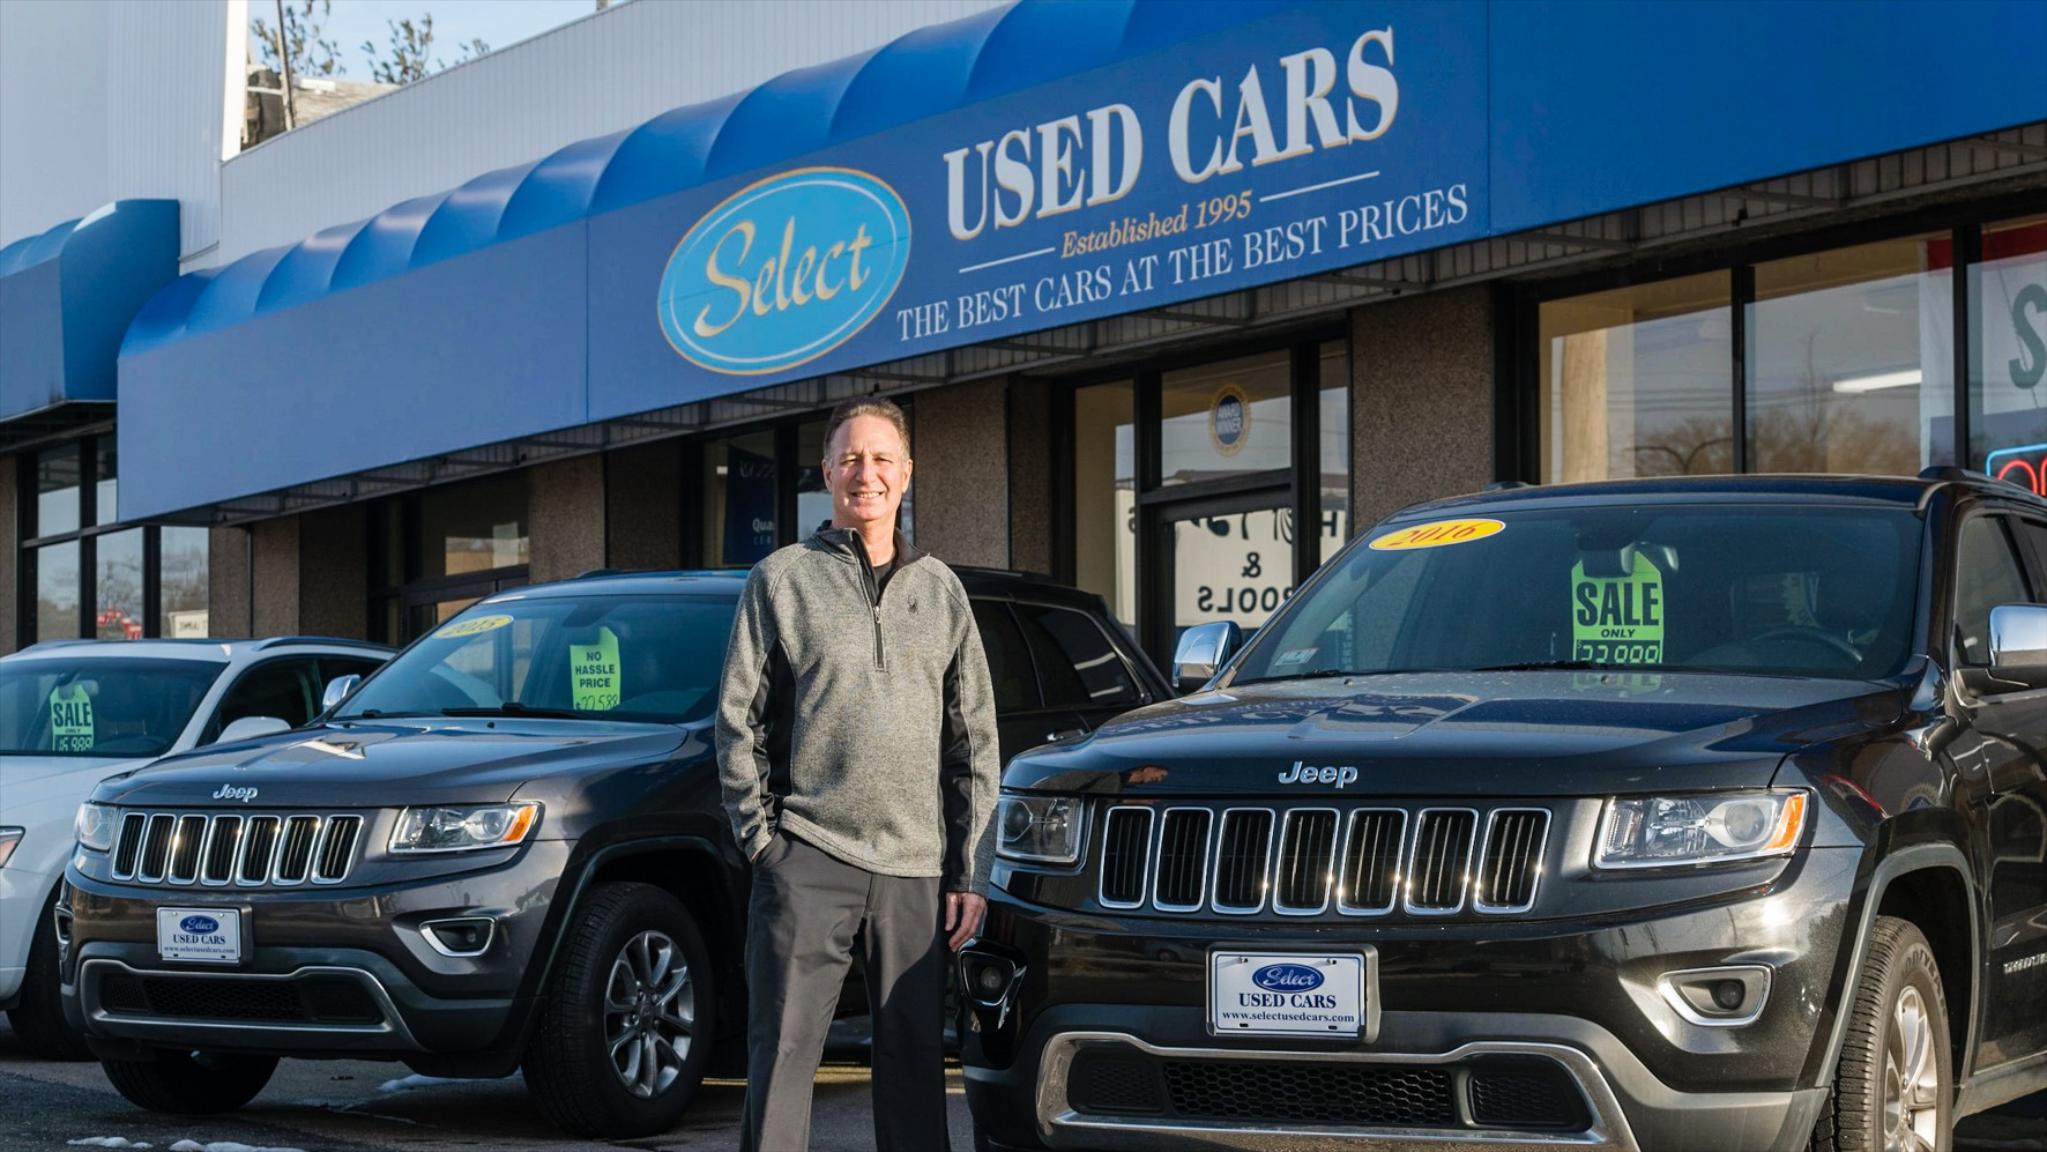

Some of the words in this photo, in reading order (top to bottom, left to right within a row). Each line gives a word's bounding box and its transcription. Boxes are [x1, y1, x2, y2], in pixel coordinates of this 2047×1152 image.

[943, 103, 1144, 240] USED
[1168, 25, 1399, 184] CARS
[1061, 203, 1189, 258] Established
[1195, 190, 1253, 229] 1995
[897, 301, 950, 342] THE
[957, 283, 1027, 329] BEST
[1034, 264, 1113, 313] CARS
[1119, 254, 1159, 296] AT
[1168, 238, 1233, 286] THE
[1242, 215, 1328, 270] BEST
[1338, 183, 1469, 249] PRICES
[694, 215, 873, 338] Select
[1388, 522, 1488, 547] 2016
[1576, 581, 1660, 627] SALE
[1600, 628, 1637, 638] ONLY
[586, 651, 602, 662] NO
[575, 664, 616, 675] HASSLE
[579, 677, 611, 688] PRICE
[53, 702, 91, 728] SALE
[1278, 760, 1358, 789] Jeep
[212, 783, 259, 802] Jeep
[173, 934, 199, 944] USED
[201, 935, 226, 945] CARS
[1262, 966, 1315, 986] Select
[1239, 992, 1286, 1008] USED
[1290, 994, 1337, 1009] CARS
[1222, 1011, 1355, 1023] www.selectusedcars.com
